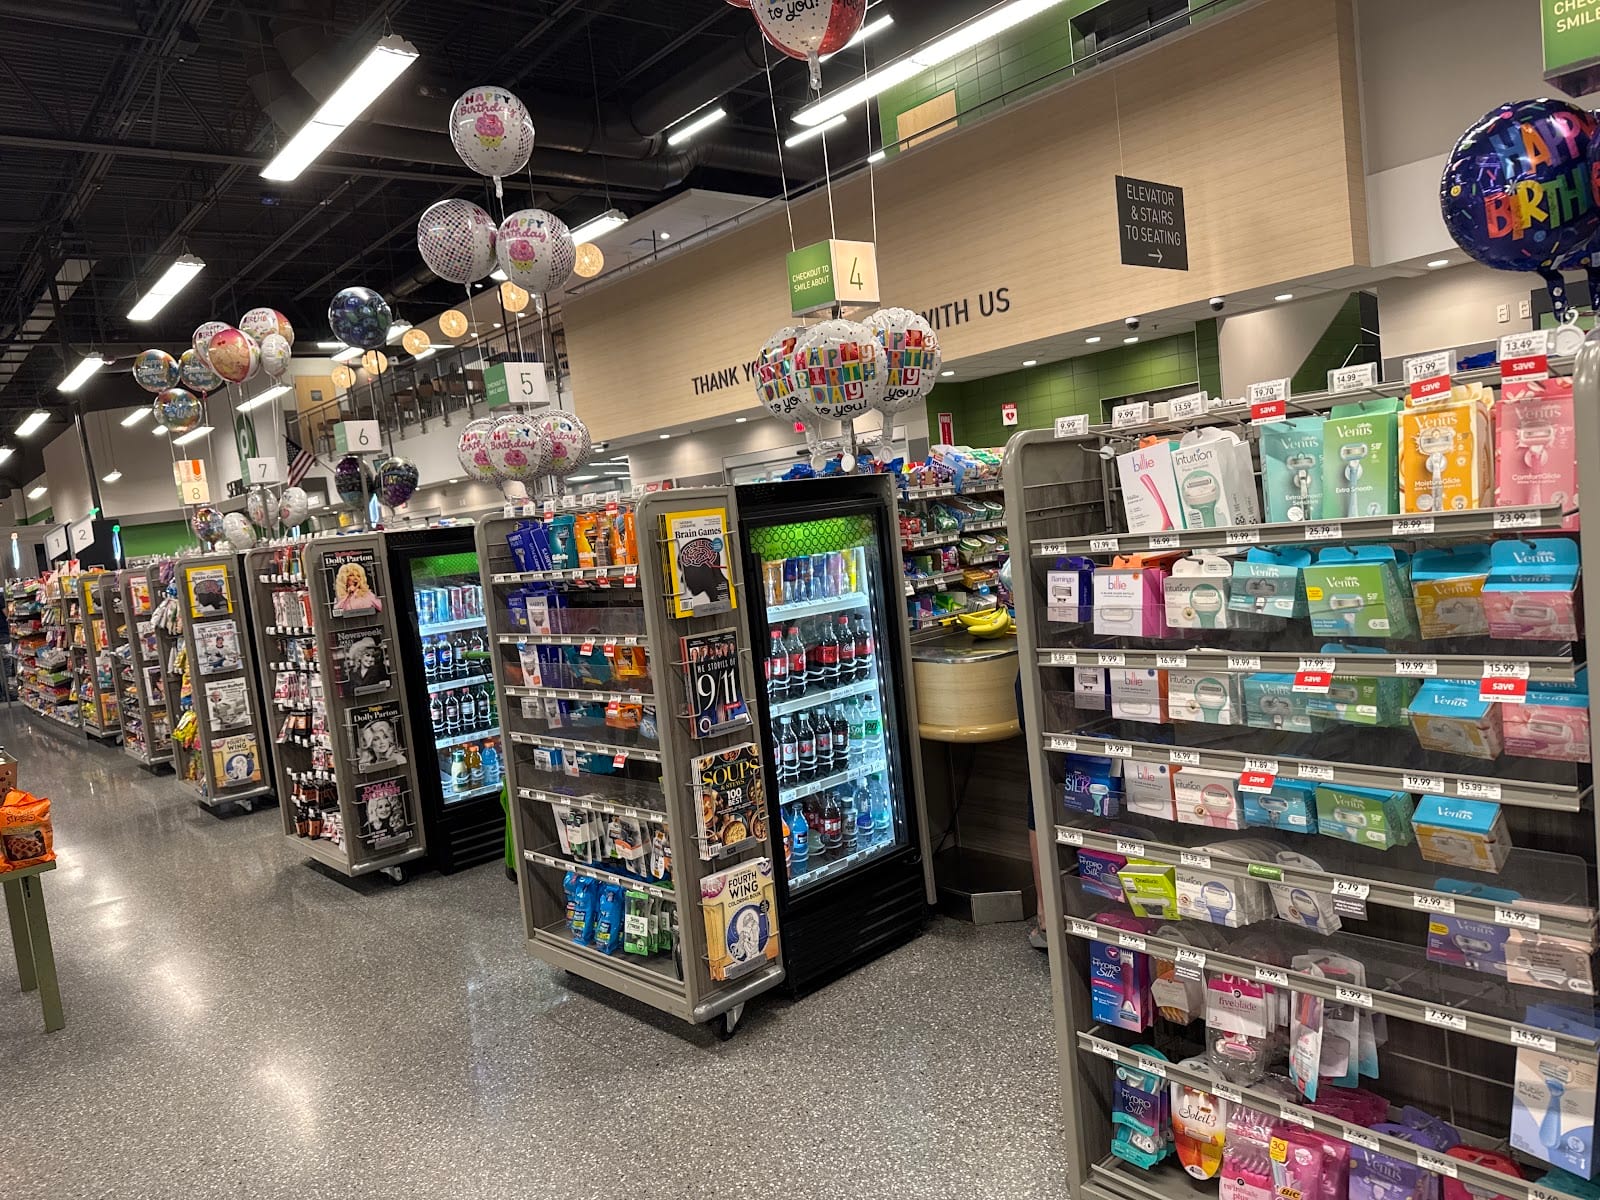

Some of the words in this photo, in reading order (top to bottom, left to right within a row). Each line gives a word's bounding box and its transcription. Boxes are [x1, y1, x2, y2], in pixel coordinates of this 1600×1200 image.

[768, 7, 783, 20] to
[465, 92, 511, 105] HAPPY
[460, 102, 517, 117] Birthday
[1126, 183, 1175, 207] ELEVATOR
[1131, 205, 1139, 221] &
[1140, 206, 1174, 226] STAIRS
[1125, 224, 1139, 241] TO
[1141, 227, 1181, 247] SEATING
[792, 266, 821, 283] CHECKOUT
[822, 264, 829, 274] TO
[849, 256, 863, 291] 4
[794, 281, 811, 293] SMILE
[811, 275, 829, 288] ABOUT
[978, 287, 1011, 318] US
[1505, 340, 1532, 351] 13.49
[1413, 362, 1436, 374] 17.99
[1512, 360, 1536, 371] save
[691, 366, 739, 395] THANK
[796, 363, 876, 389] BIRTH
[1337, 373, 1356, 384] 14.99
[520, 372, 534, 395] 5
[1420, 381, 1441, 393] save
[810, 382, 864, 404] DAY
[1254, 387, 1274, 397] 19.70
[814, 404, 831, 415] to
[833, 399, 868, 418] you!
[1174, 402, 1192, 412] 13.59
[1259, 405, 1277, 415] save
[1117, 410, 1134, 419] 9.99
[1414, 412, 1458, 428] Venus
[1060, 421, 1076, 430] 9.99
[1336, 425, 1373, 438] Venus
[359, 428, 368, 446] 6
[1280, 437, 1319, 450] Venus
[490, 438, 536, 450] Birthday
[1132, 454, 1156, 473] billie
[1175, 448, 1213, 466] Intuition
[258, 463, 267, 478] 7
[192, 487, 201, 501] 8
[1499, 512, 1526, 523] 23.99
[1309, 526, 1330, 536] 25.79
[1398, 520, 1422, 529] 28.99
[78, 529, 87, 541] 2
[674, 529, 697, 539] Brain
[698, 527, 722, 537] Games
[1229, 532, 1249, 541] 19.99
[54, 538, 60, 548] 1
[1092, 541, 1109, 549] 17.99
[1152, 537, 1170, 545] 16.99
[1044, 544, 1059, 552] 9.99
[325, 555, 346, 566] Dolly
[347, 554, 373, 563] Parton
[1512, 551, 1556, 563] Venus
[1249, 565, 1280, 577] Venus
[1107, 575, 1127, 591] billie
[1325, 576, 1360, 589] Venus
[337, 627, 382, 641] Newsweek
[1160, 656, 1177, 664] 16.99
[1231, 658, 1250, 667] 19.99
[1303, 659, 1324, 667] 17.99
[1400, 661, 1424, 670] 19.99
[1489, 663, 1515, 673] 15.99
[1124, 671, 1143, 687] billie
[1303, 675, 1322, 683] save
[697, 668, 738, 711] 9/11
[1491, 682, 1515, 691] save
[1433, 693, 1469, 708] Venus
[353, 713, 373, 723] Dolly
[374, 709, 398, 720] Parton
[1108, 744, 1124, 753] 9.99
[1173, 751, 1191, 760] 16.99
[702, 758, 760, 786] SOUPS
[1137, 765, 1155, 782] billie
[1249, 775, 1266, 784] save
[1407, 777, 1431, 786] 19.99
[364, 780, 397, 794] DOLLY
[727, 787, 742, 800] 100
[1064, 778, 1090, 796] SILK
[728, 796, 743, 807] BEST
[1333, 793, 1366, 810] Venus
[1437, 805, 1473, 821] Venus
[1084, 865, 1100, 877] Silk
[728, 871, 757, 889] FOURTH
[1337, 881, 1359, 892] 6.79
[729, 880, 759, 899] WING
[1418, 895, 1441, 906] 29.99
[1500, 910, 1526, 921] 14.99
[1456, 920, 1495, 936] Venus
[1092, 956, 1121, 973] HYDRO
[1096, 966, 1116, 980] Silk
[1259, 968, 1279, 979] 6.99
[1340, 988, 1361, 999] 8.99
[1218, 996, 1257, 1011] fiveblade
[1516, 1029, 1542, 1043] 14.99
[1121, 1091, 1151, 1109] HYDRO
[1125, 1102, 1145, 1119] Silk
[1179, 1104, 1211, 1122] Soleil
[1271, 1140, 1286, 1152] 30
[1363, 1150, 1402, 1182] Venus
[1280, 1188, 1301, 1200] BIC
